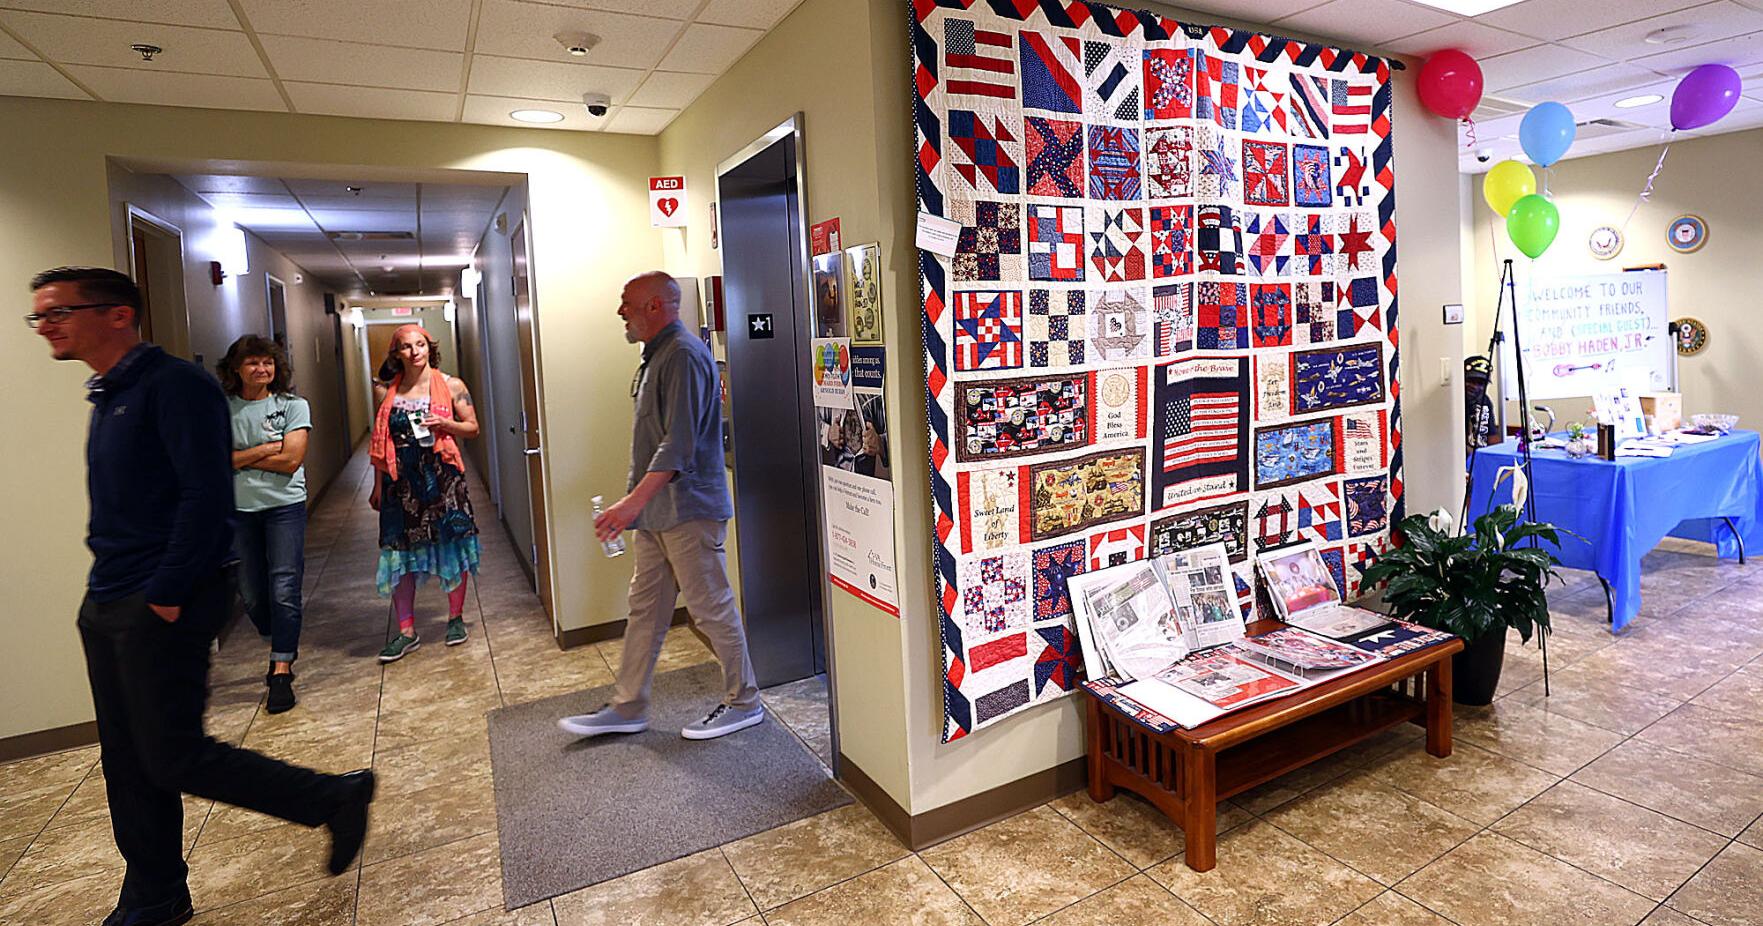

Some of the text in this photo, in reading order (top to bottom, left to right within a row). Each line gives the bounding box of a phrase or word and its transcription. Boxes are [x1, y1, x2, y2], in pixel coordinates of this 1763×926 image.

[1188, 26, 1203, 35] USA
[655, 179, 678, 189] AED
[1532, 281, 1643, 301] WELCOME TO OUR
[1525, 304, 1591, 321] COMMUNITY
[765, 316, 771, 331] 1
[1541, 326, 1563, 338] AND
[1532, 342, 1572, 357] BOBBY
[854, 367, 864, 378] that
[1194, 364, 1208, 373] the
[1210, 364, 1234, 372] Brave
[1107, 411, 1121, 419] God
[1104, 430, 1128, 438] America
[1167, 486, 1192, 500] United
[1202, 480, 1226, 493] Stand
[974, 504, 1015, 518] Sweet Land
[991, 518, 1000, 529] of
[984, 531, 1008, 542] Liberty
